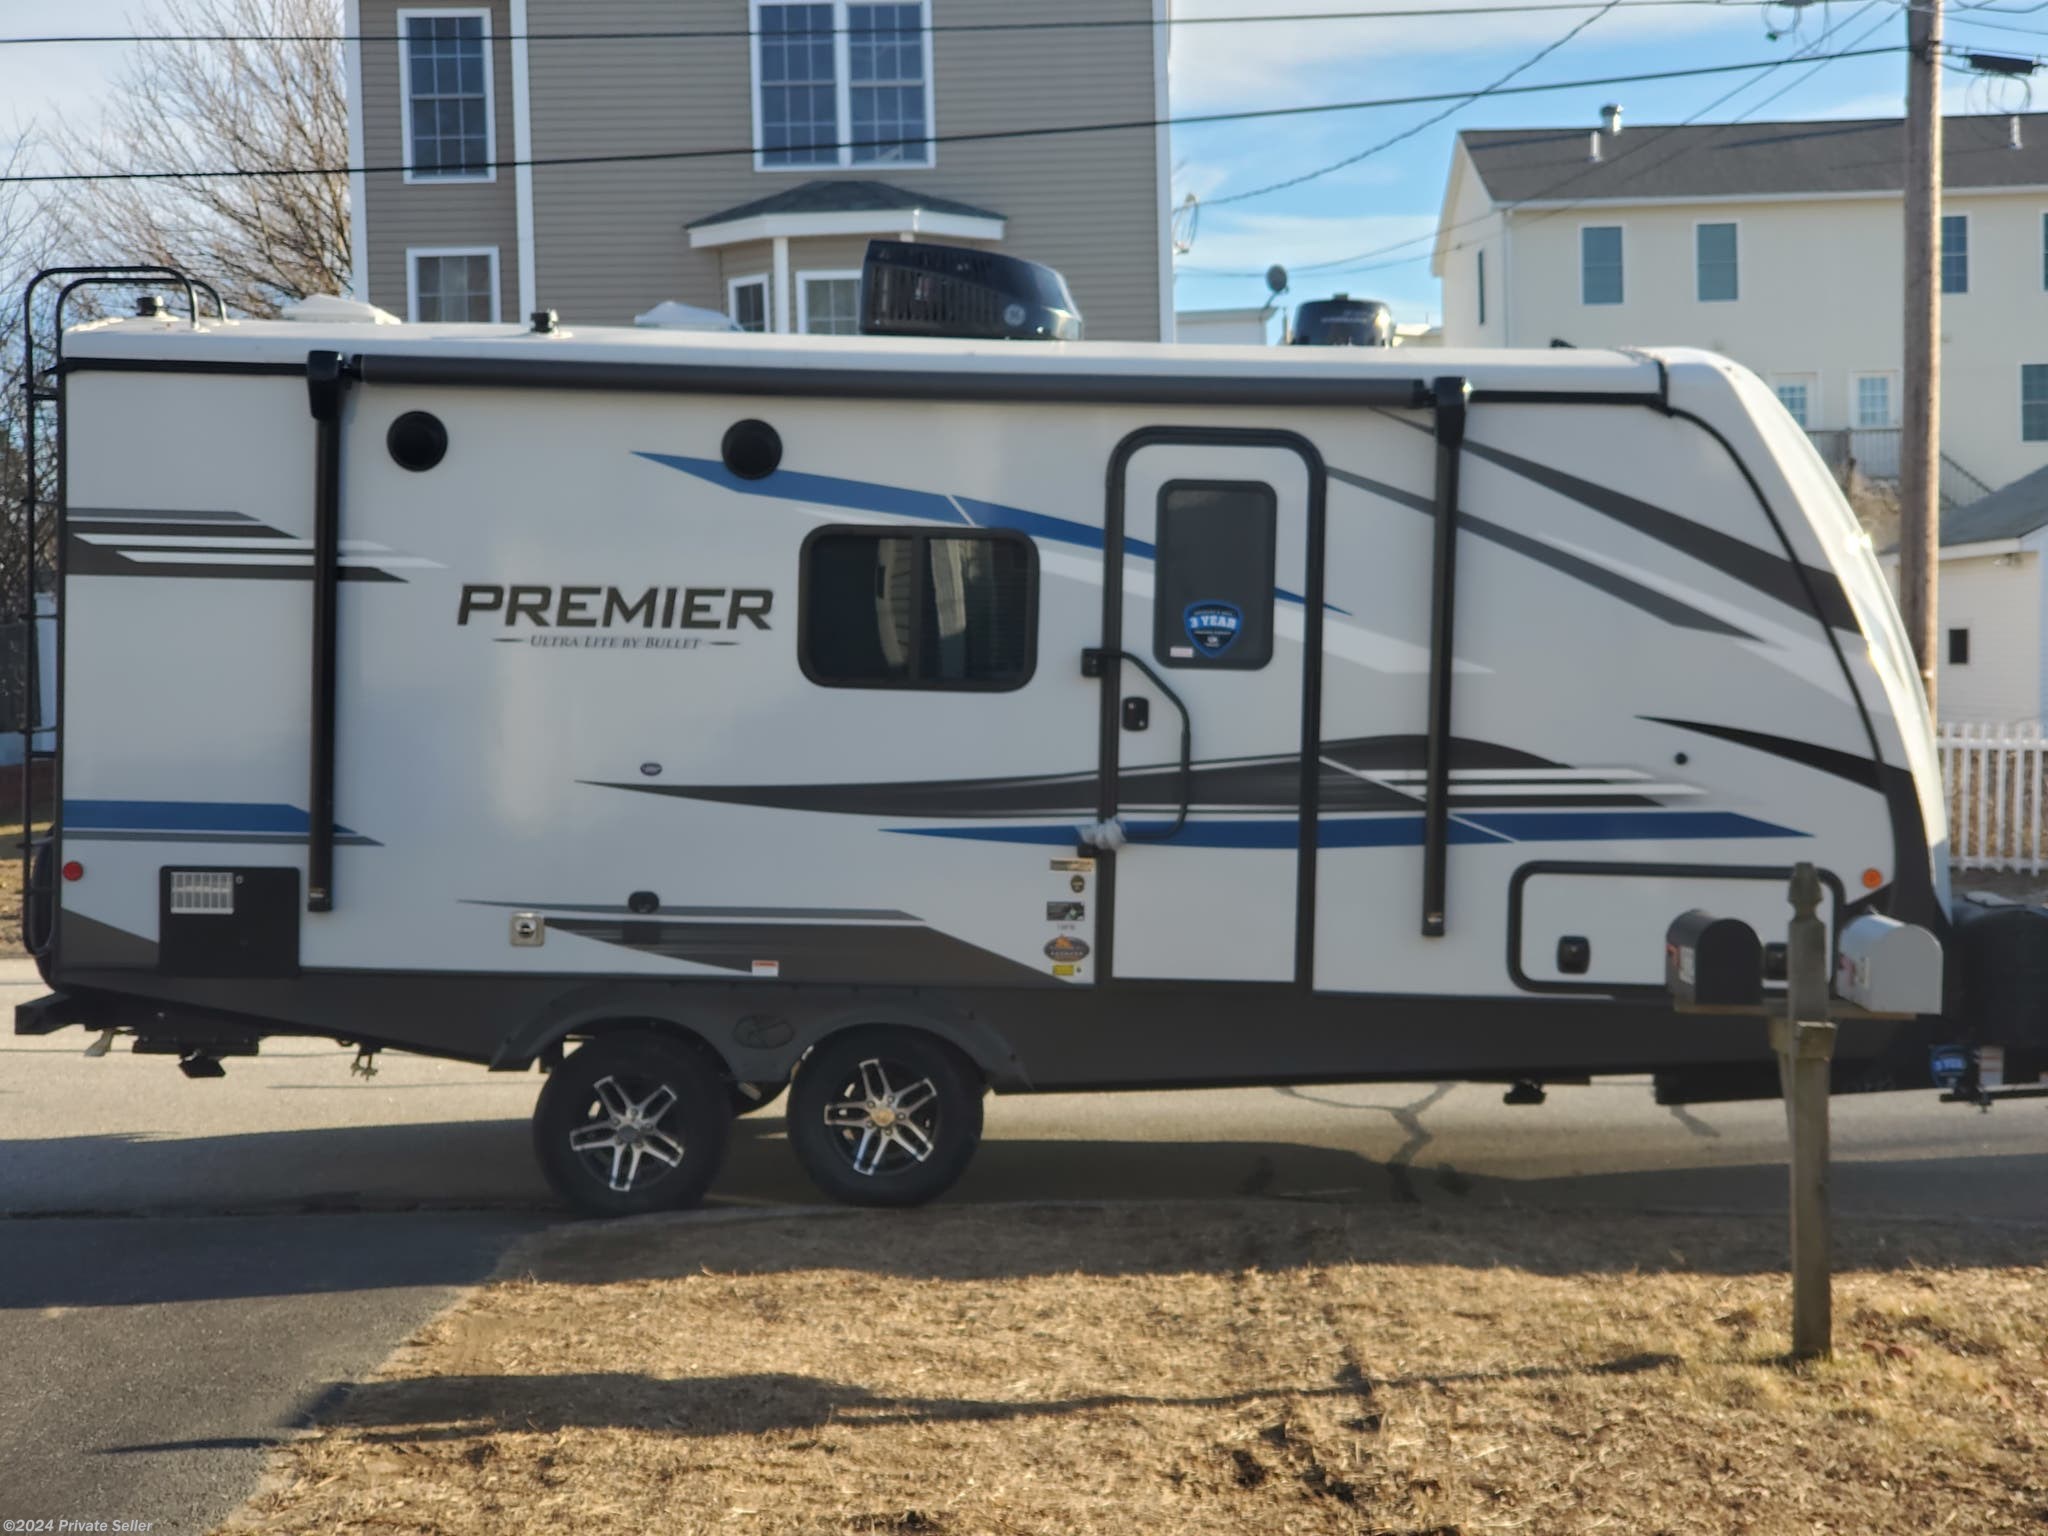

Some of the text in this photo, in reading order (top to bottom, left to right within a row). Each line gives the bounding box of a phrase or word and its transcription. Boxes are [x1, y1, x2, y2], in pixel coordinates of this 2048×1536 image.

[457, 584, 774, 630] PREMIER
[1200, 615, 1237, 629] YEAR
[530, 635, 578, 647] ULTRA
[645, 636, 702, 649] BULLET
